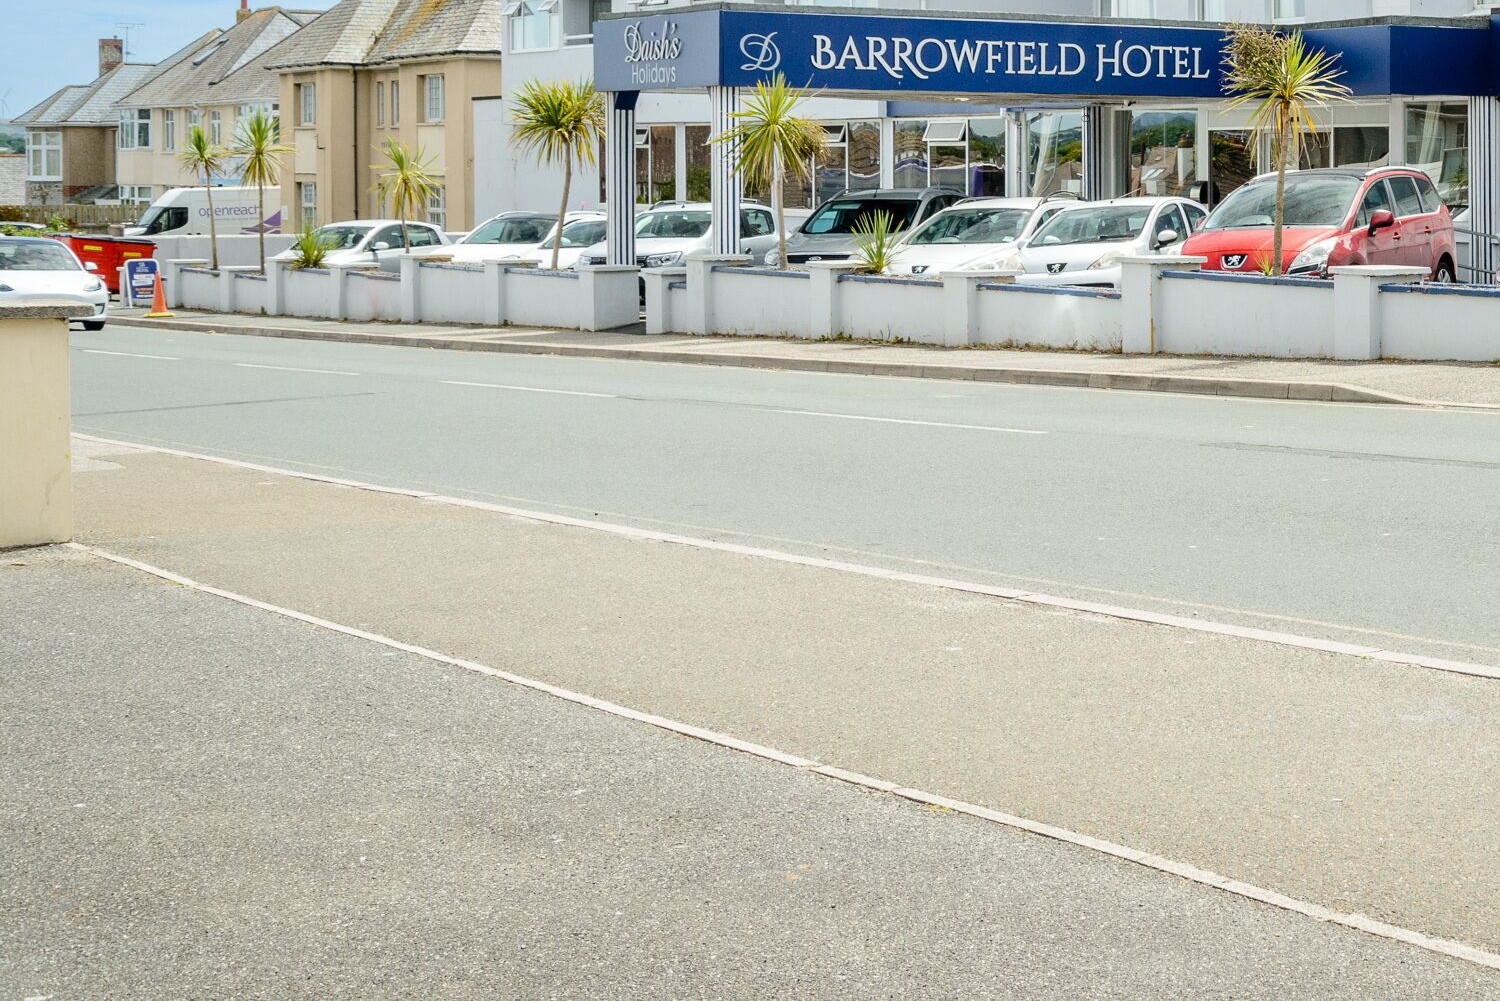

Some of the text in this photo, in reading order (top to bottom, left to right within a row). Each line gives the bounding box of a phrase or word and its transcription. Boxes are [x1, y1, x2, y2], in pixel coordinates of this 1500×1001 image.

[624, 21, 682, 63] Daish's
[810, 34, 1210, 82] BARROWFIELD HOTEL
[631, 64, 676, 87] Holidays
